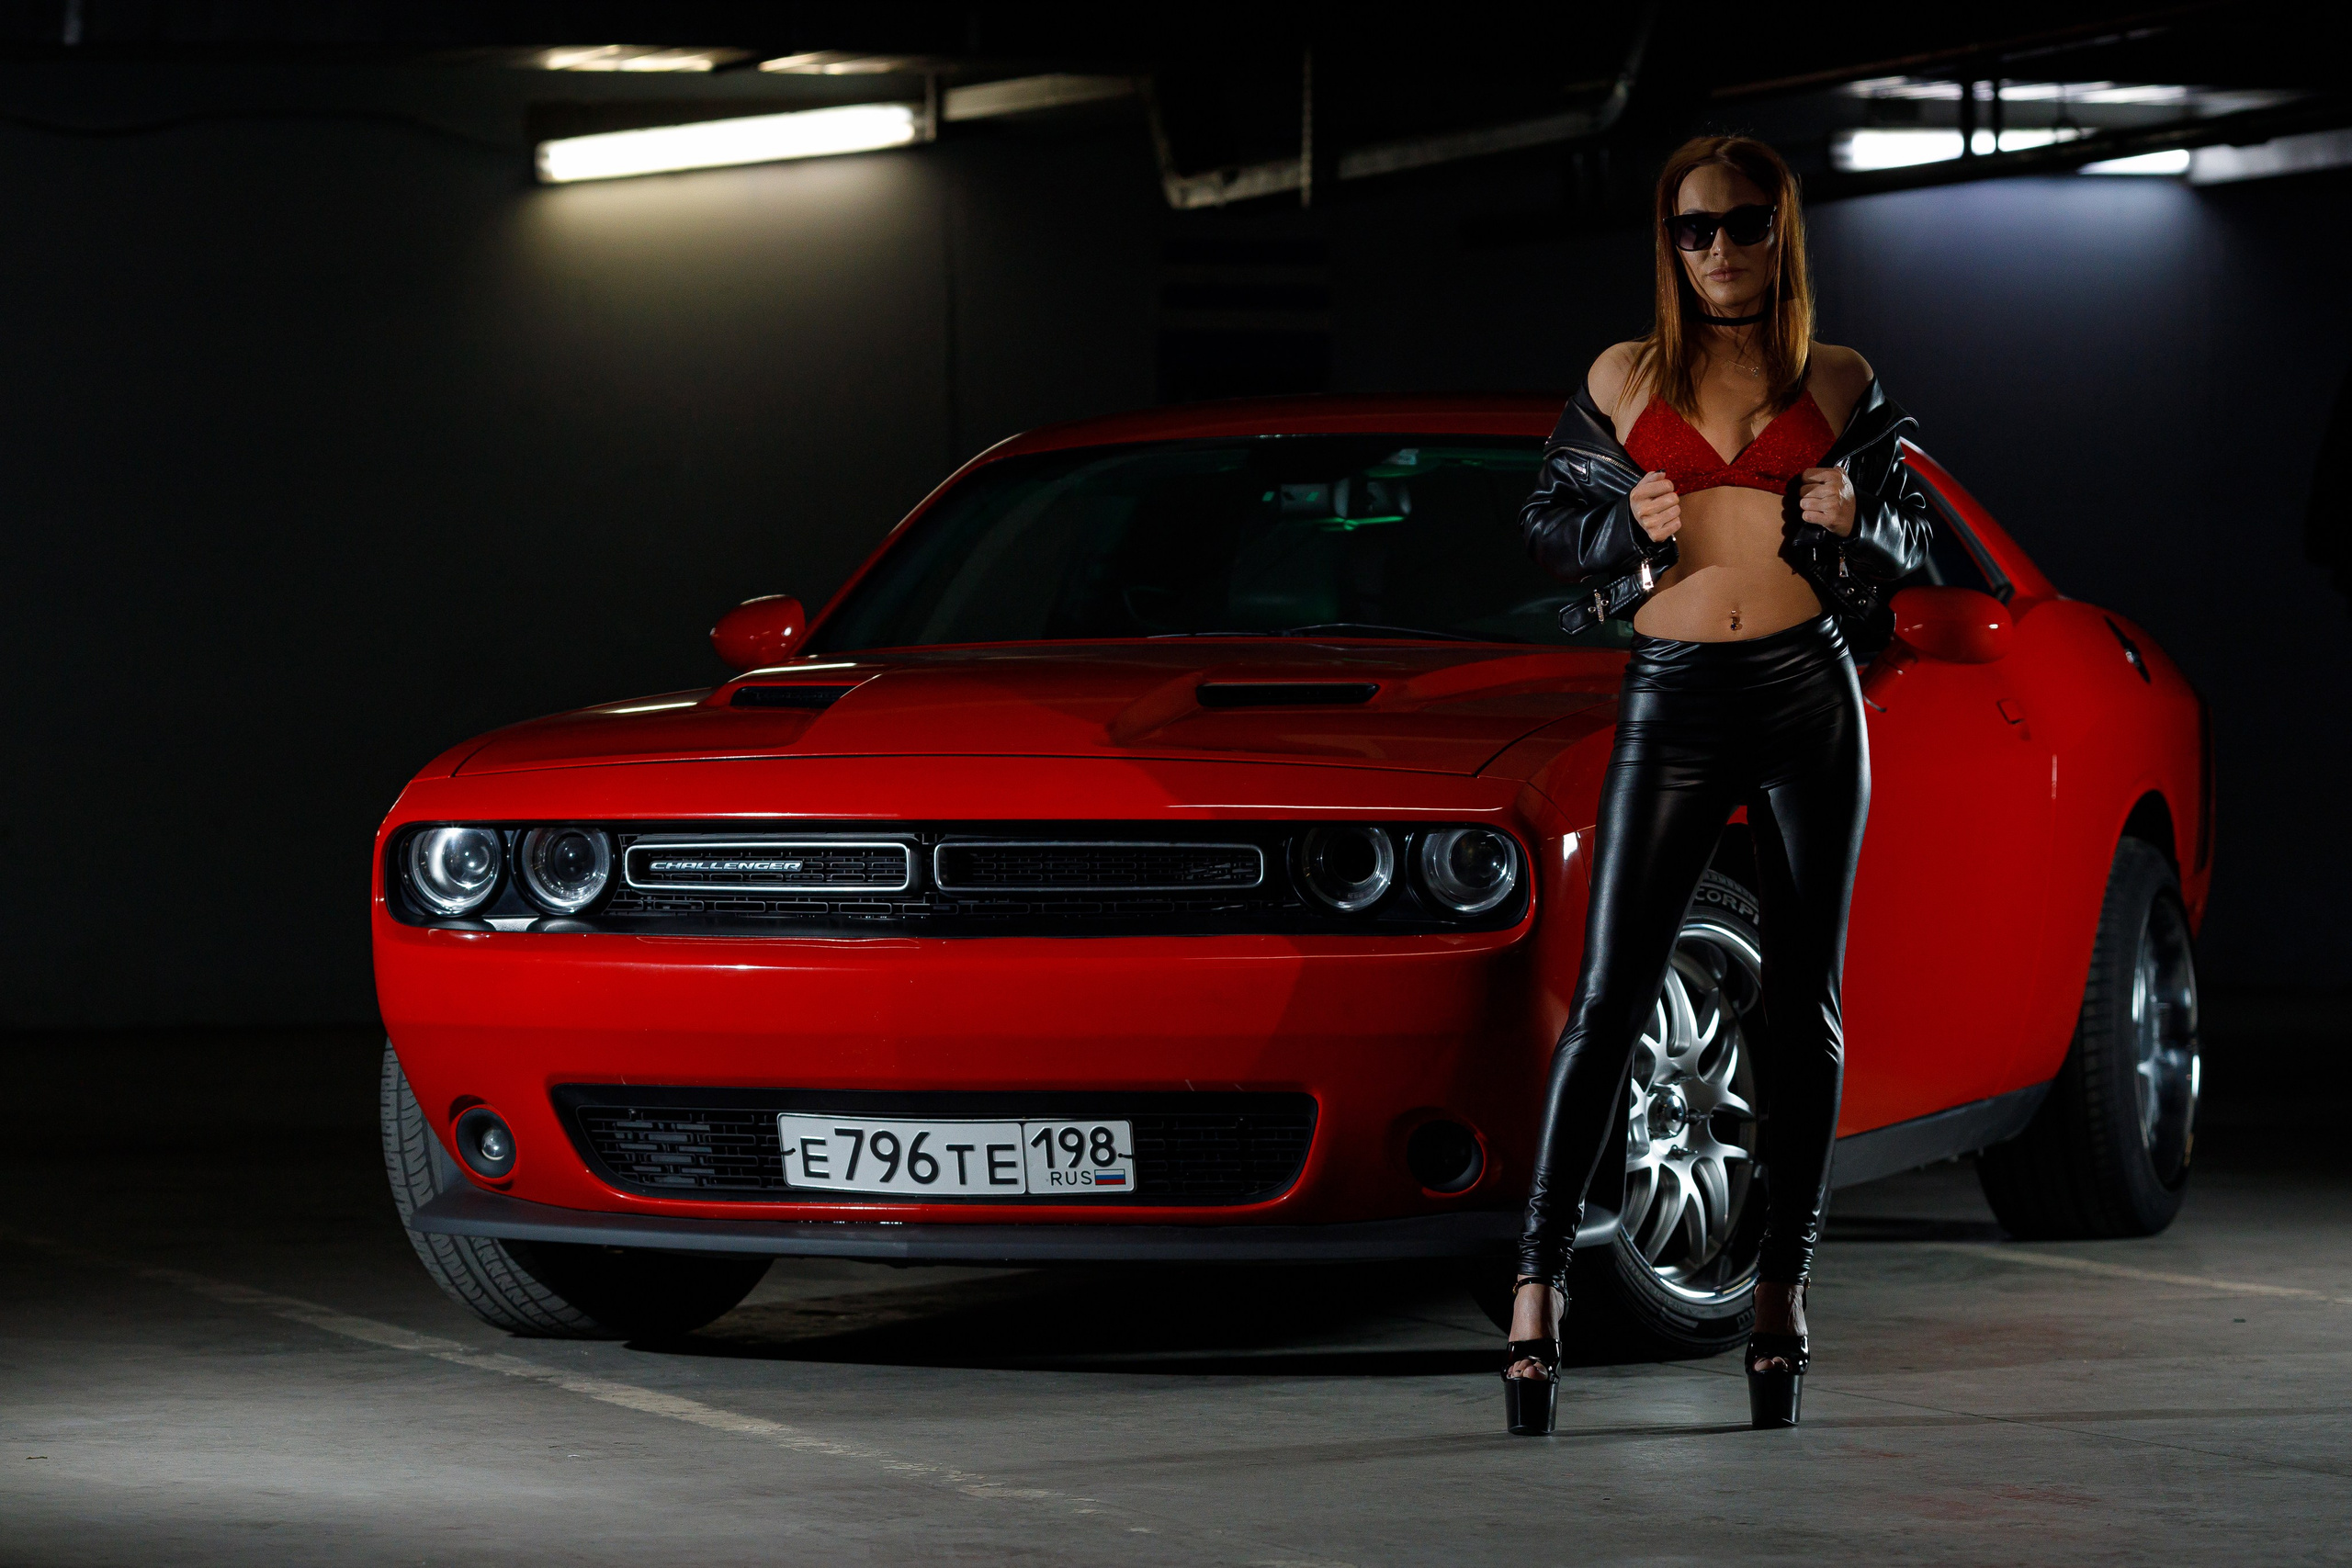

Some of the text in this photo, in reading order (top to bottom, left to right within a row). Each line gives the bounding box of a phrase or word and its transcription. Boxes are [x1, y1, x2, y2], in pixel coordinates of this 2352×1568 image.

[650, 862, 802, 871] CHALLENGER
[1031, 1126, 1115, 1168] 198
[1050, 1171, 1092, 1186] RUS
